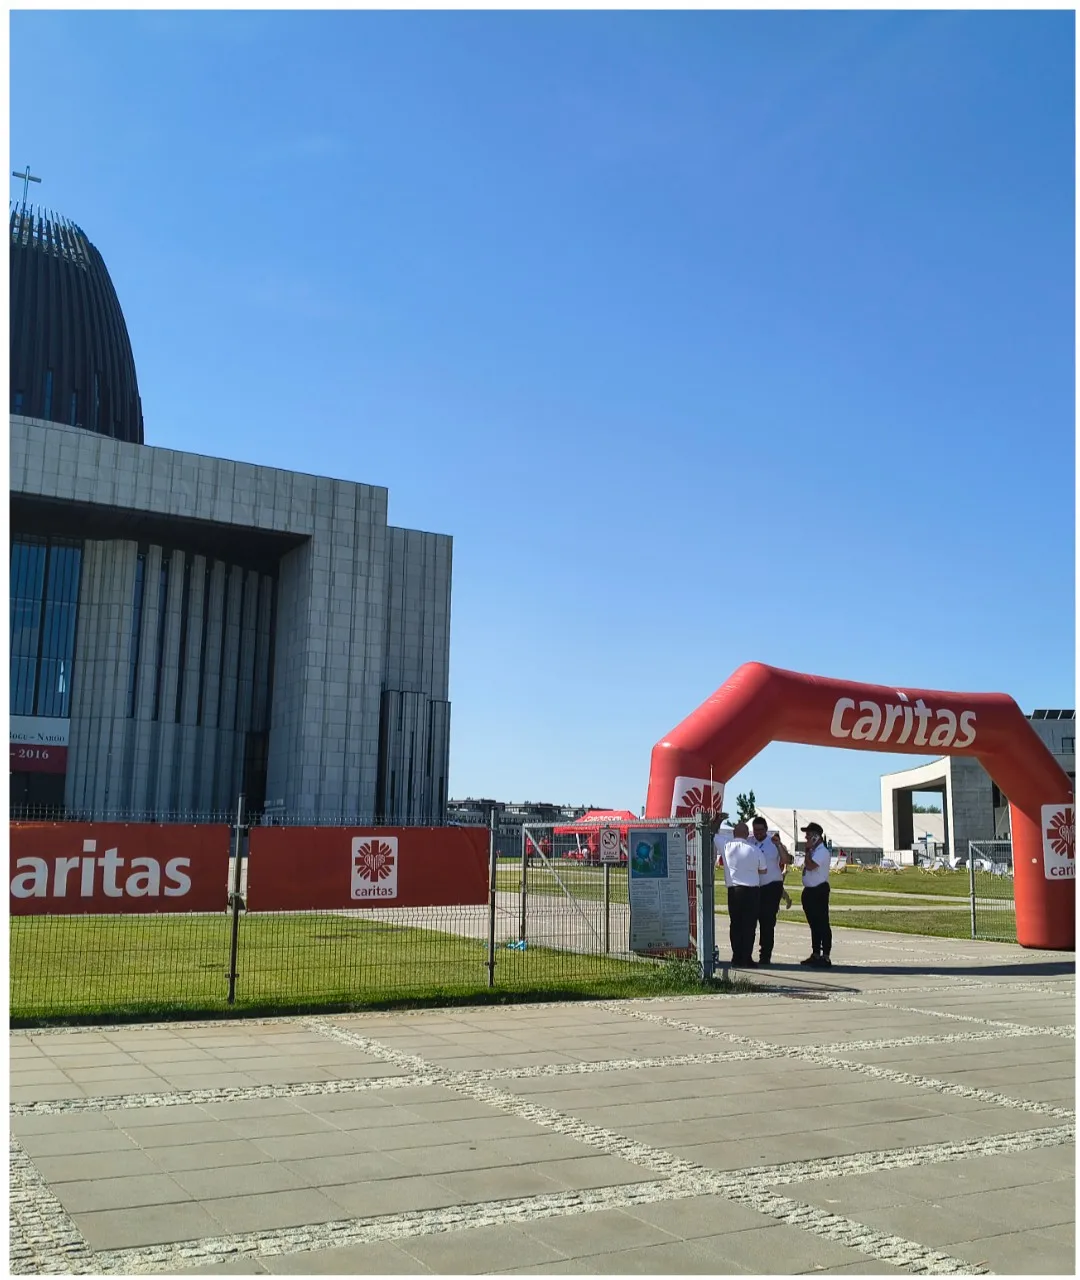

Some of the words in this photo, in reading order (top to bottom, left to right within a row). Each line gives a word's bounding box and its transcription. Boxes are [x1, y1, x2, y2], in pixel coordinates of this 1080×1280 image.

[831, 690, 976, 748] caritas
[19, 748, 49, 760] 2016
[355, 885, 393, 897] caritas
